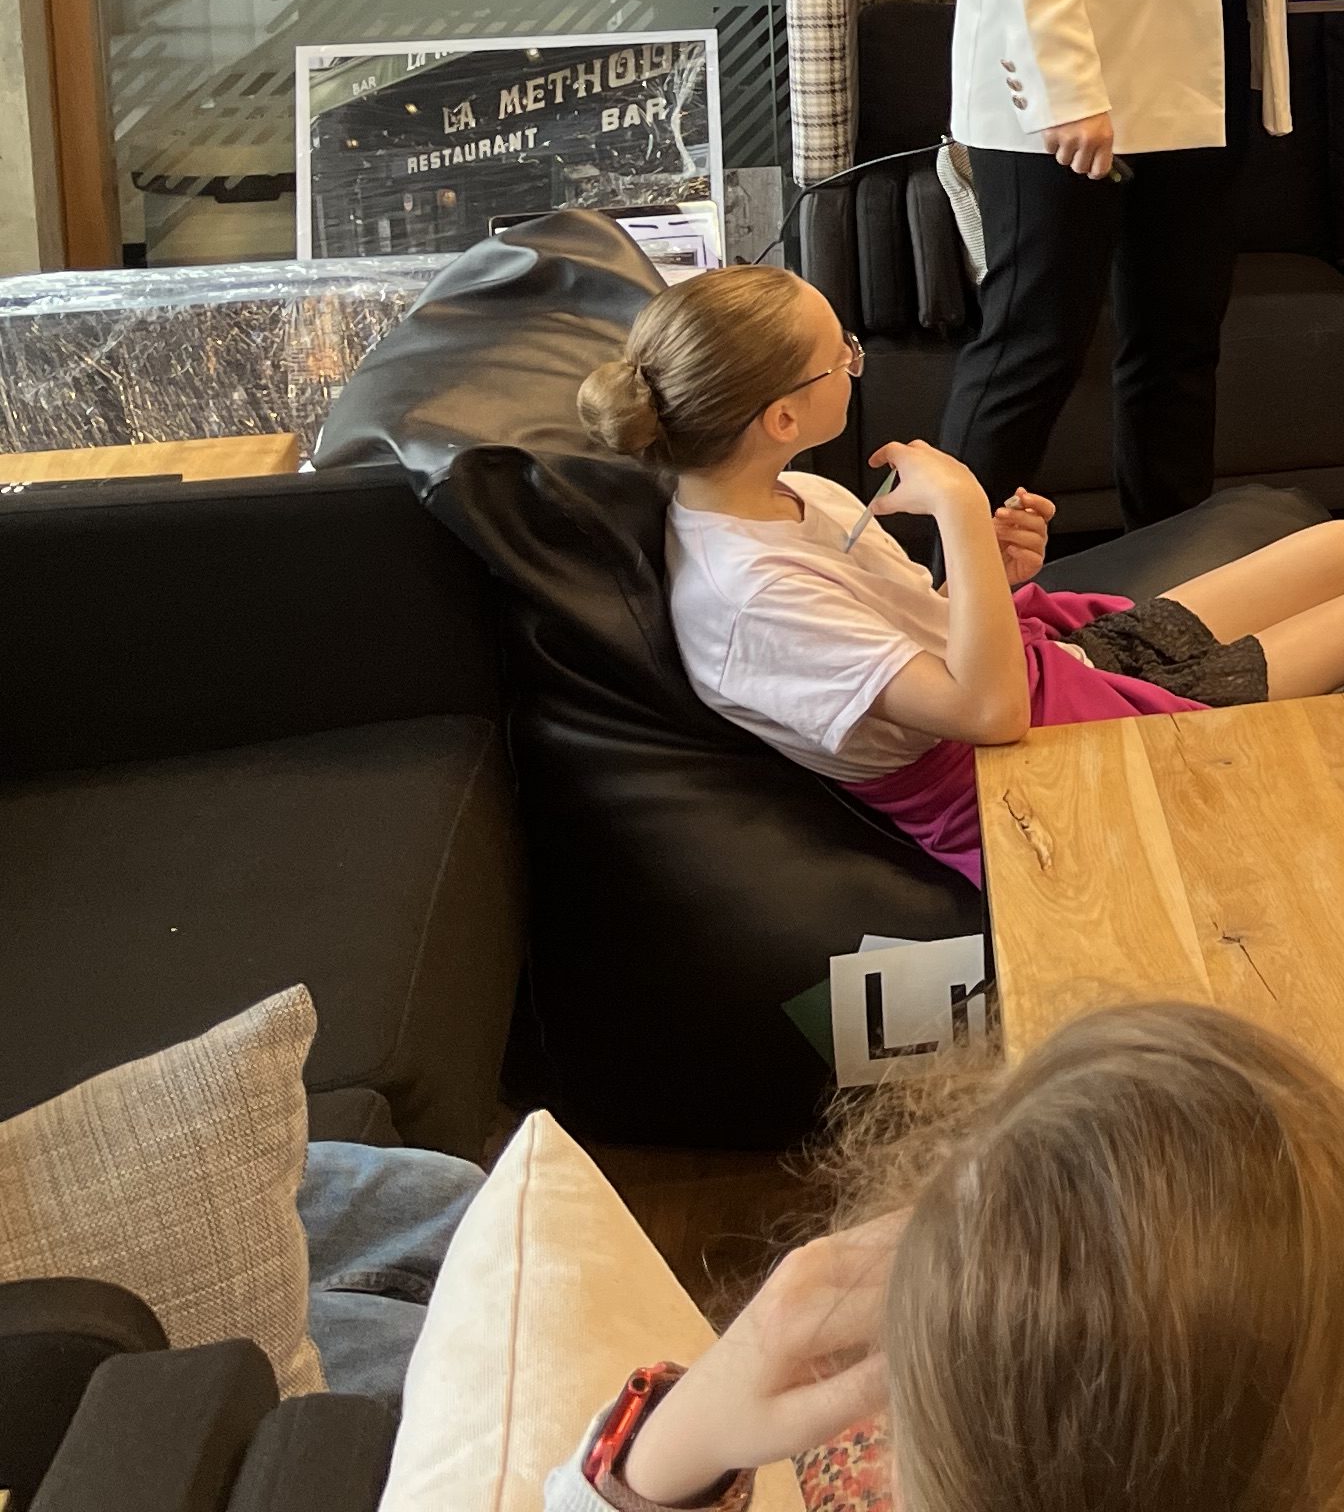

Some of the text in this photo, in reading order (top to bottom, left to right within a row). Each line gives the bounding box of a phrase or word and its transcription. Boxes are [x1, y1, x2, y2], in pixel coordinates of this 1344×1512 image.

[352, 76, 377, 96] BAR
[442, 42, 704, 135] LA METHOD
[406, 96, 669, 175] RESTAURANT BAR
